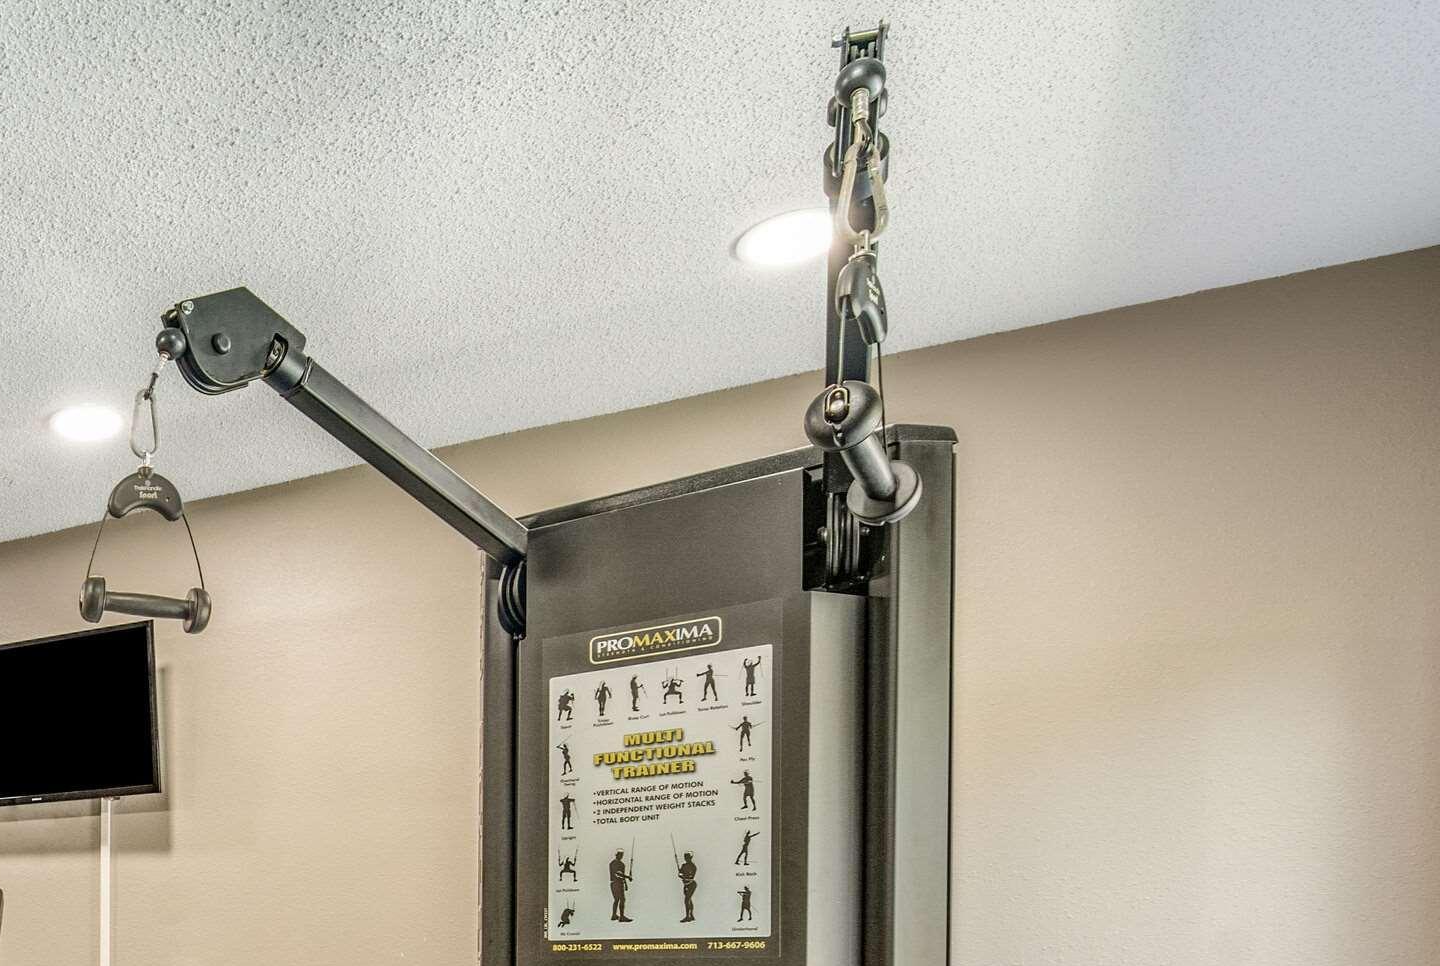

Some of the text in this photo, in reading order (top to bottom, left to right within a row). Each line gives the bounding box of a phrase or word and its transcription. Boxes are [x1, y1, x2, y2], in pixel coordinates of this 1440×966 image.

[597, 624, 714, 654] PROMAXIMA
[623, 728, 683, 747] MULTI
[593, 741, 716, 767] FUNCTIONAL
[612, 760, 697, 780] TRAINER
[596, 781, 704, 798] VERTICAL RANGE OF MOTION
[596, 789, 719, 807] HORIZONTAL RANGE OF MOTION
[602, 805, 653, 815] INDEPENDENT
[655, 802, 686, 811] WEIGHT
[687, 800, 716, 809] STACKS
[596, 814, 660, 826] TOTAL BODY UNIT
[552, 941, 766, 952] 800-231-6522 www.promaxima.com 713-667-9606
